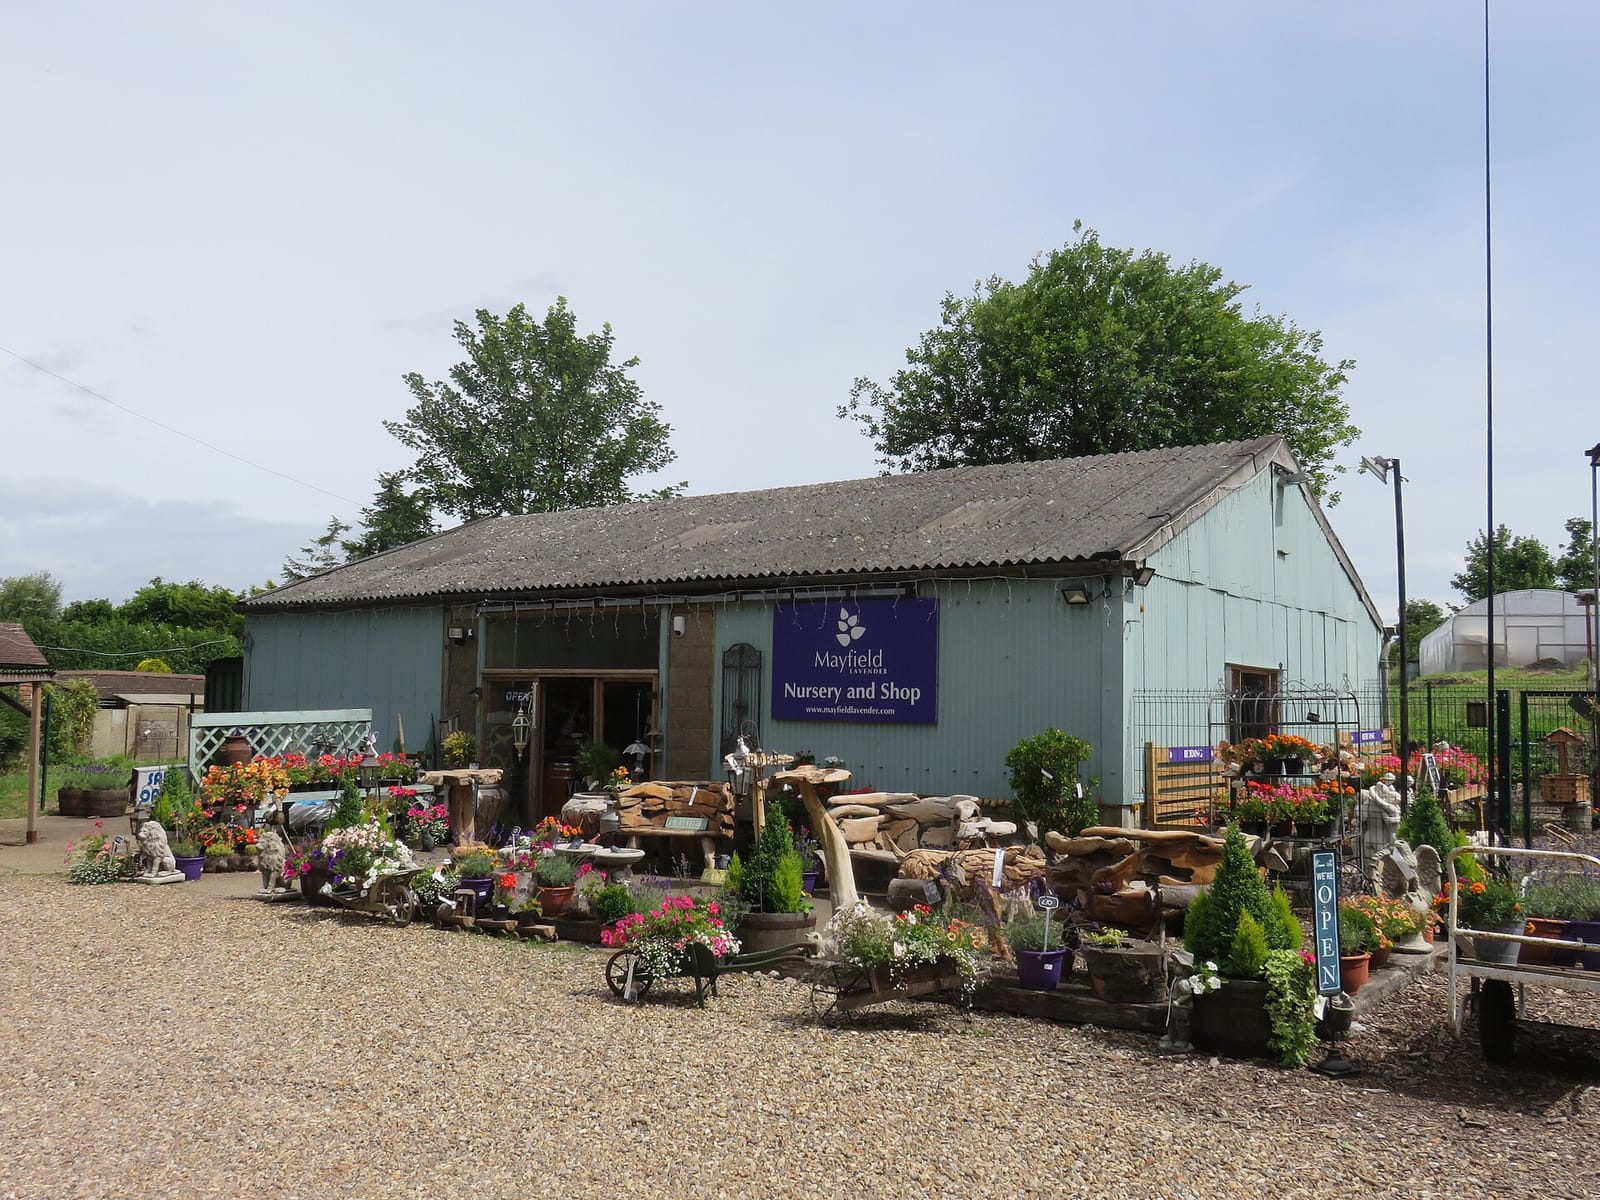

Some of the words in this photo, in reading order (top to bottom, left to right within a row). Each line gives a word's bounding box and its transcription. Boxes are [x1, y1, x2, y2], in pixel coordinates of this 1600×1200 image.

[814, 649, 883, 673] Mayfield
[784, 682, 842, 704] Nursery
[846, 681, 876, 699] and
[880, 681, 921, 706] Shop
[805, 705, 896, 716] www.mayfieldlavender.com
[1318, 885, 1337, 985] OPEN
